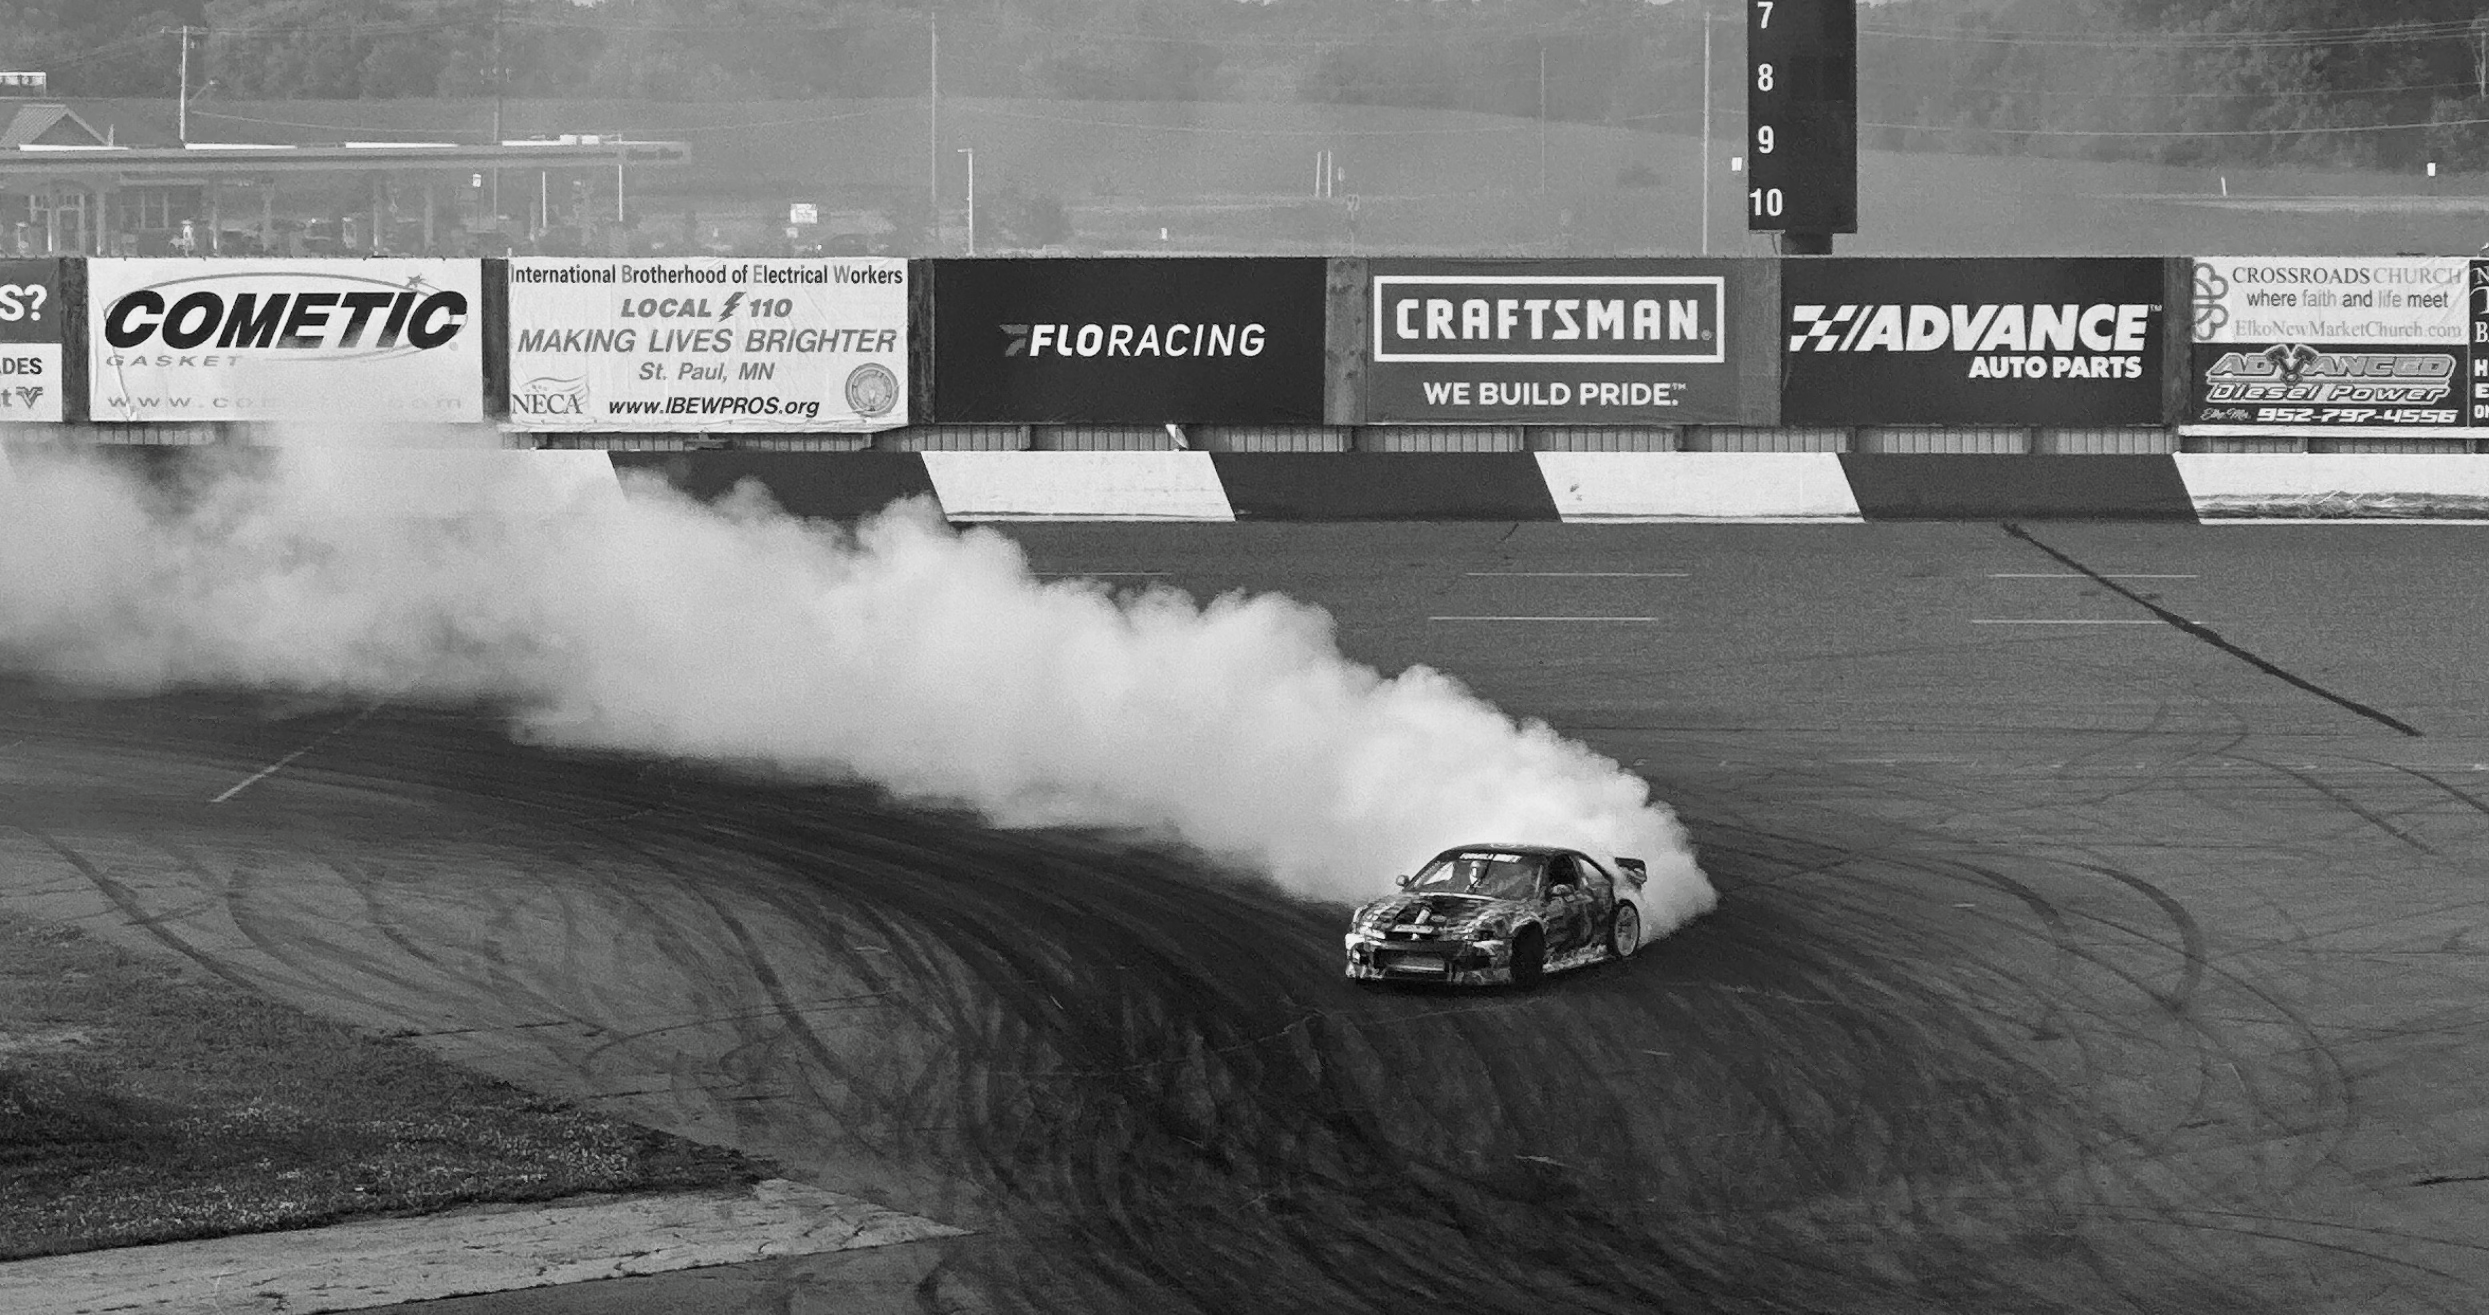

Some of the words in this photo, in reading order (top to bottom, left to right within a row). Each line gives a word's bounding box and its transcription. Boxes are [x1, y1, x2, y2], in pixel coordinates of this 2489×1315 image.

[1757, 1, 1774, 29] 7
[1757, 63, 1774, 91] 8
[1757, 125, 1775, 154] 9
[1749, 188, 1783, 216] 10
[510, 264, 616, 284] International
[622, 264, 727, 284] Brotherhood
[731, 264, 748, 284] of
[753, 264, 828, 284] Electrical
[834, 264, 903, 285] Workers
[2232, 267, 2370, 284] CROSSROADS
[2373, 267, 2462, 285] CHURCH
[621, 298, 712, 318] LOCAL
[750, 298, 793, 318] 110
[2247, 290, 2297, 308] where
[2302, 290, 2337, 307] faith
[2342, 290, 2372, 308] and
[2379, 289, 2401, 308] life
[2407, 291, 2448, 308] meet
[104, 289, 468, 350] COMETIC
[2236, 320, 2462, 338] ElkoNewMarketChurch.com
[518, 329, 636, 353] MAKING
[649, 329, 732, 353] LIVES
[745, 329, 897, 353] BRIGHTER
[1030, 323, 1266, 357] FLORACING
[0, 357, 43, 375] DES
[106, 354, 239, 368] GASKET
[1969, 356, 2048, 379] AUTO
[2053, 356, 2142, 379] PARTS
[639, 362, 667, 381] St.
[678, 362, 728, 383] Paul,
[739, 362, 776, 380] MN
[512, 393, 582, 415] NECA
[1423, 382, 1470, 406] WE
[1479, 382, 1571, 406] BUILD
[2212, 384, 2320, 401] Diesel
[2329, 385, 2448, 402] Power
[609, 396, 820, 418] www.IBEWPROS.org
[2257, 407, 2458, 423] 952-797-4556
